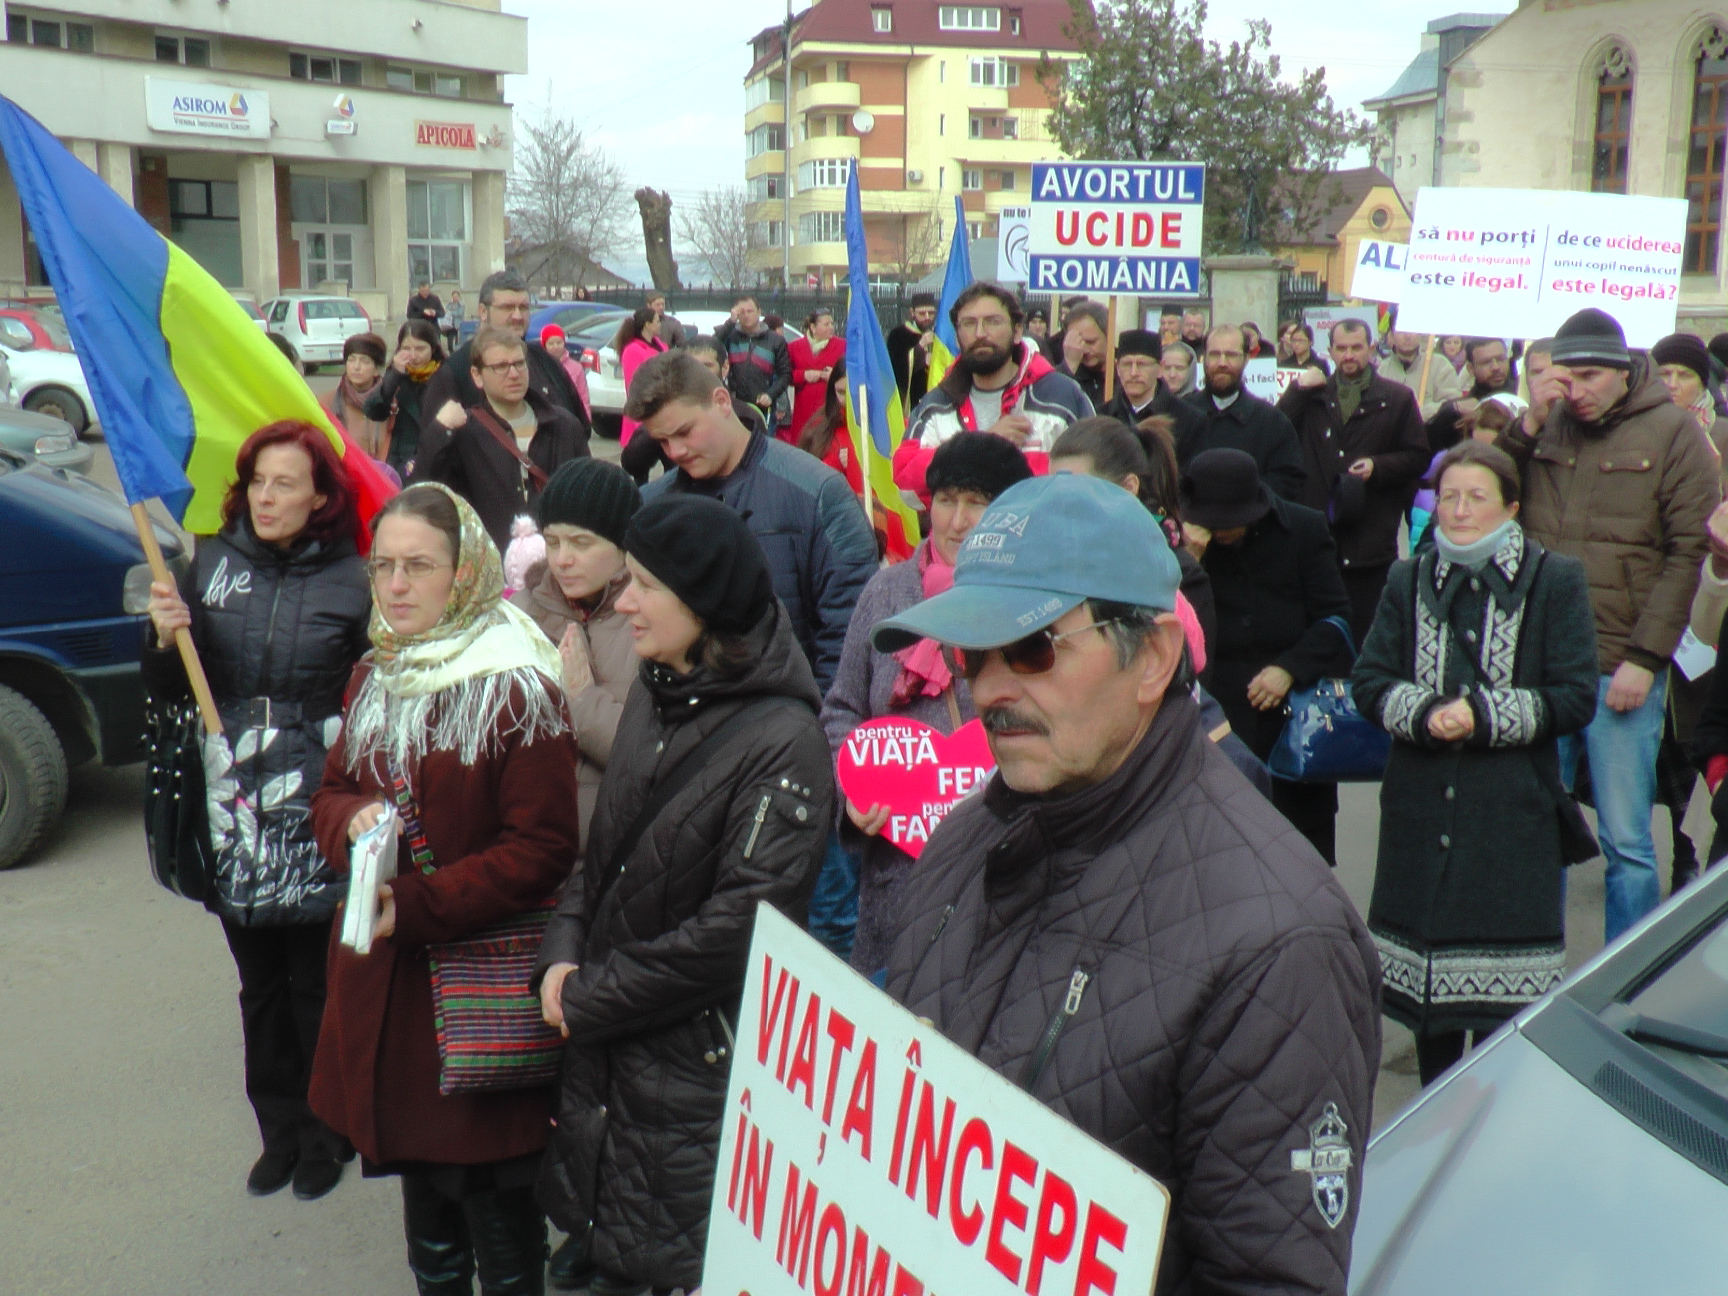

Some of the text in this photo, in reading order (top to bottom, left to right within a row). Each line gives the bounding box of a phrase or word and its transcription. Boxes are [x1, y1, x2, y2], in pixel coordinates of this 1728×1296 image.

[173, 96, 227, 115] ASIROM
[417, 123, 475, 147] APICOLA
[1040, 167, 1195, 199] AVORTUL
[1055, 209, 1182, 248] UCIDE
[1417, 225, 1440, 240] să
[1446, 229, 1475, 242] nu
[1557, 230, 1682, 254] de ce uciderea
[1459, 253, 1474, 264] de
[1554, 259, 1582, 268] unui
[1586, 260, 1617, 272] copil
[1038, 255, 1191, 290] ROMÂNIA
[1410, 271, 1529, 293] este ilegal.
[1552, 278, 1677, 301] este legală?
[855, 725, 912, 744] pentru
[847, 729, 939, 771] VIAȚĂ
[757, 952, 1129, 1296] VIAȚA ÎNCEPE
[727, 1086, 775, 1242] ÎN
